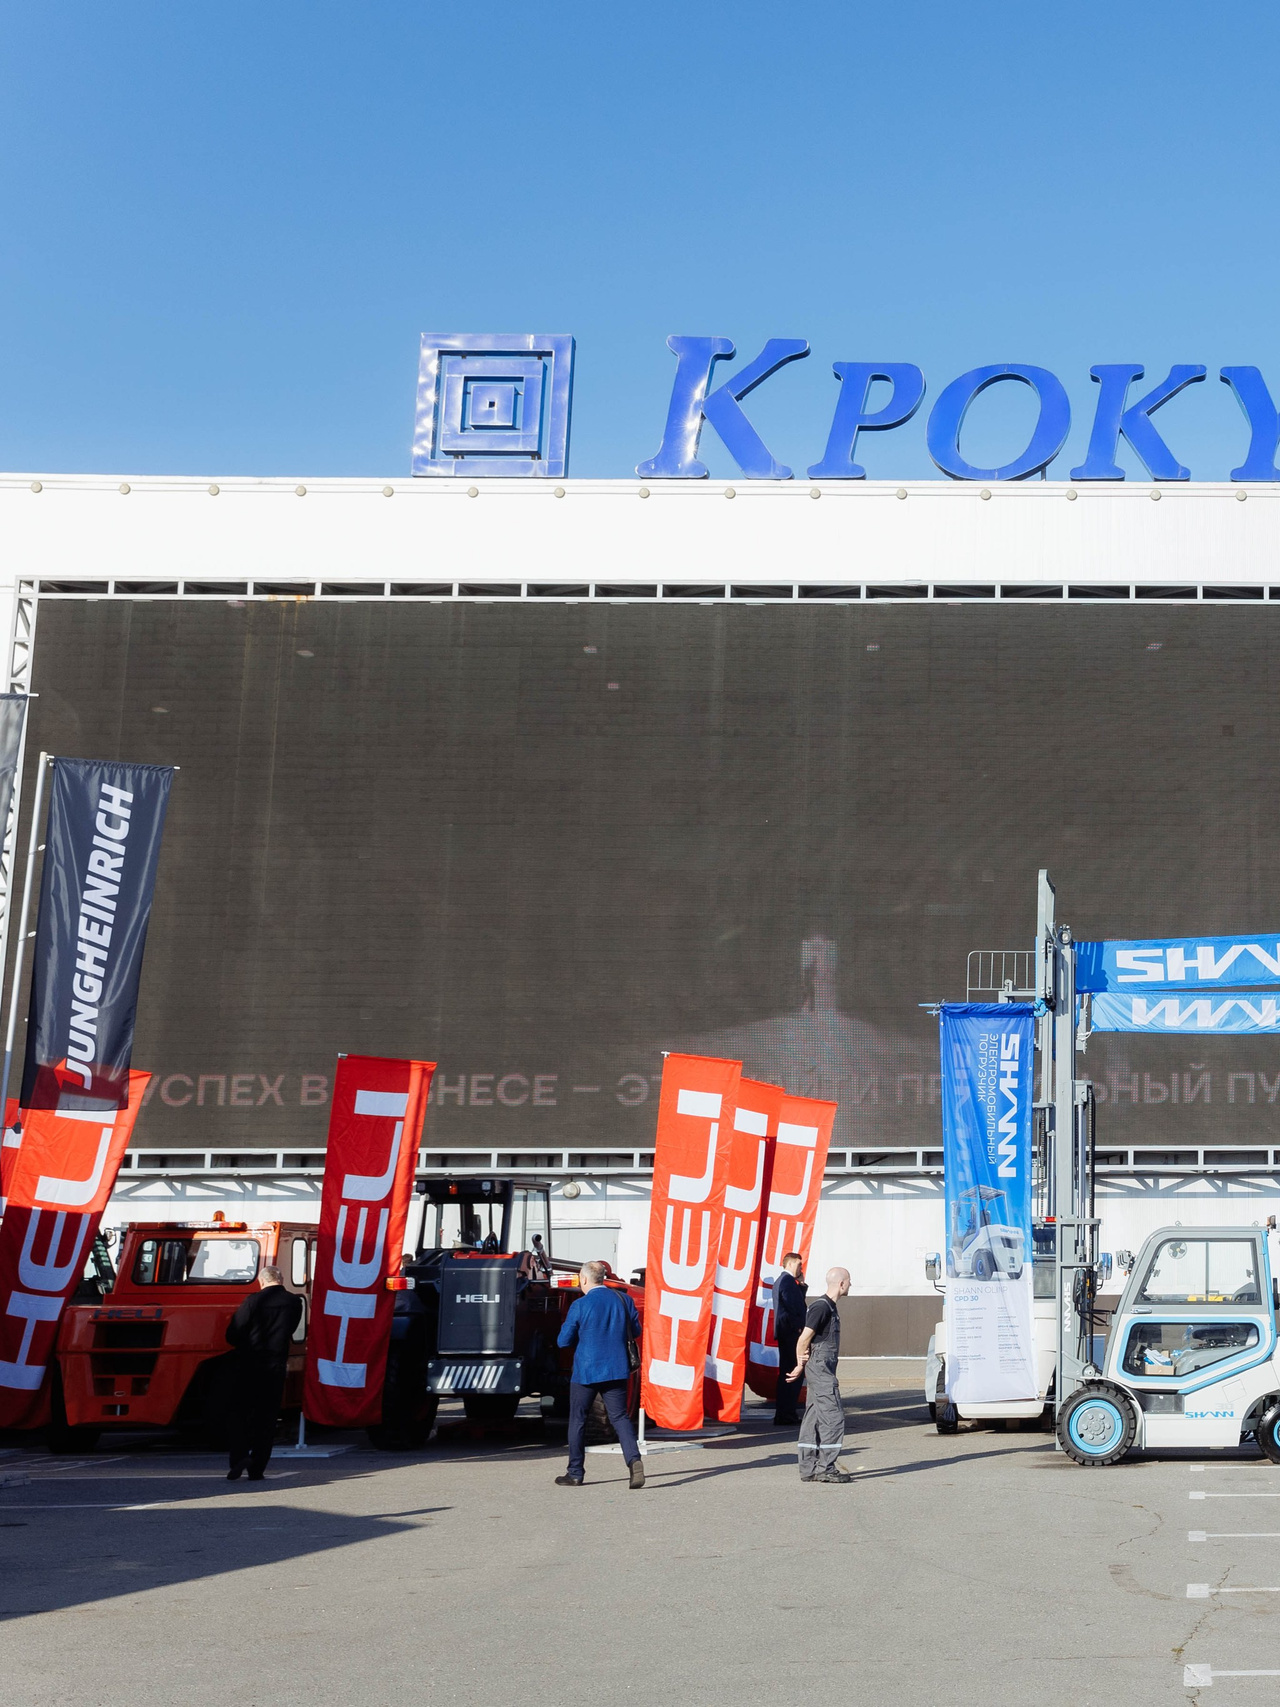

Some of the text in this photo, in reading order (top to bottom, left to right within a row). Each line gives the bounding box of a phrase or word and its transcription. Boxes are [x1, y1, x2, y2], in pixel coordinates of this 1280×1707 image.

[65, 783, 134, 1090] JUNGHEINRICH
[977, 1033, 989, 1102] ПОГРУЗЧИК
[987, 1033, 999, 1165] ЭЛЕКТРОМОБИЛЬНЫЙ
[998, 1033, 1020, 1178] SHANN
[0, 1092, 119, 1390] HELI
[317, 1089, 410, 1389] HELI
[456, 1294, 500, 1303] HELI
[649, 1089, 723, 1391] HELI
[704, 1107, 769, 1386] HELI
[1064, 1281, 1072, 1333] SHANN
[93, 1309, 164, 1320] HELI
[1185, 1410, 1234, 1419] SHANN
